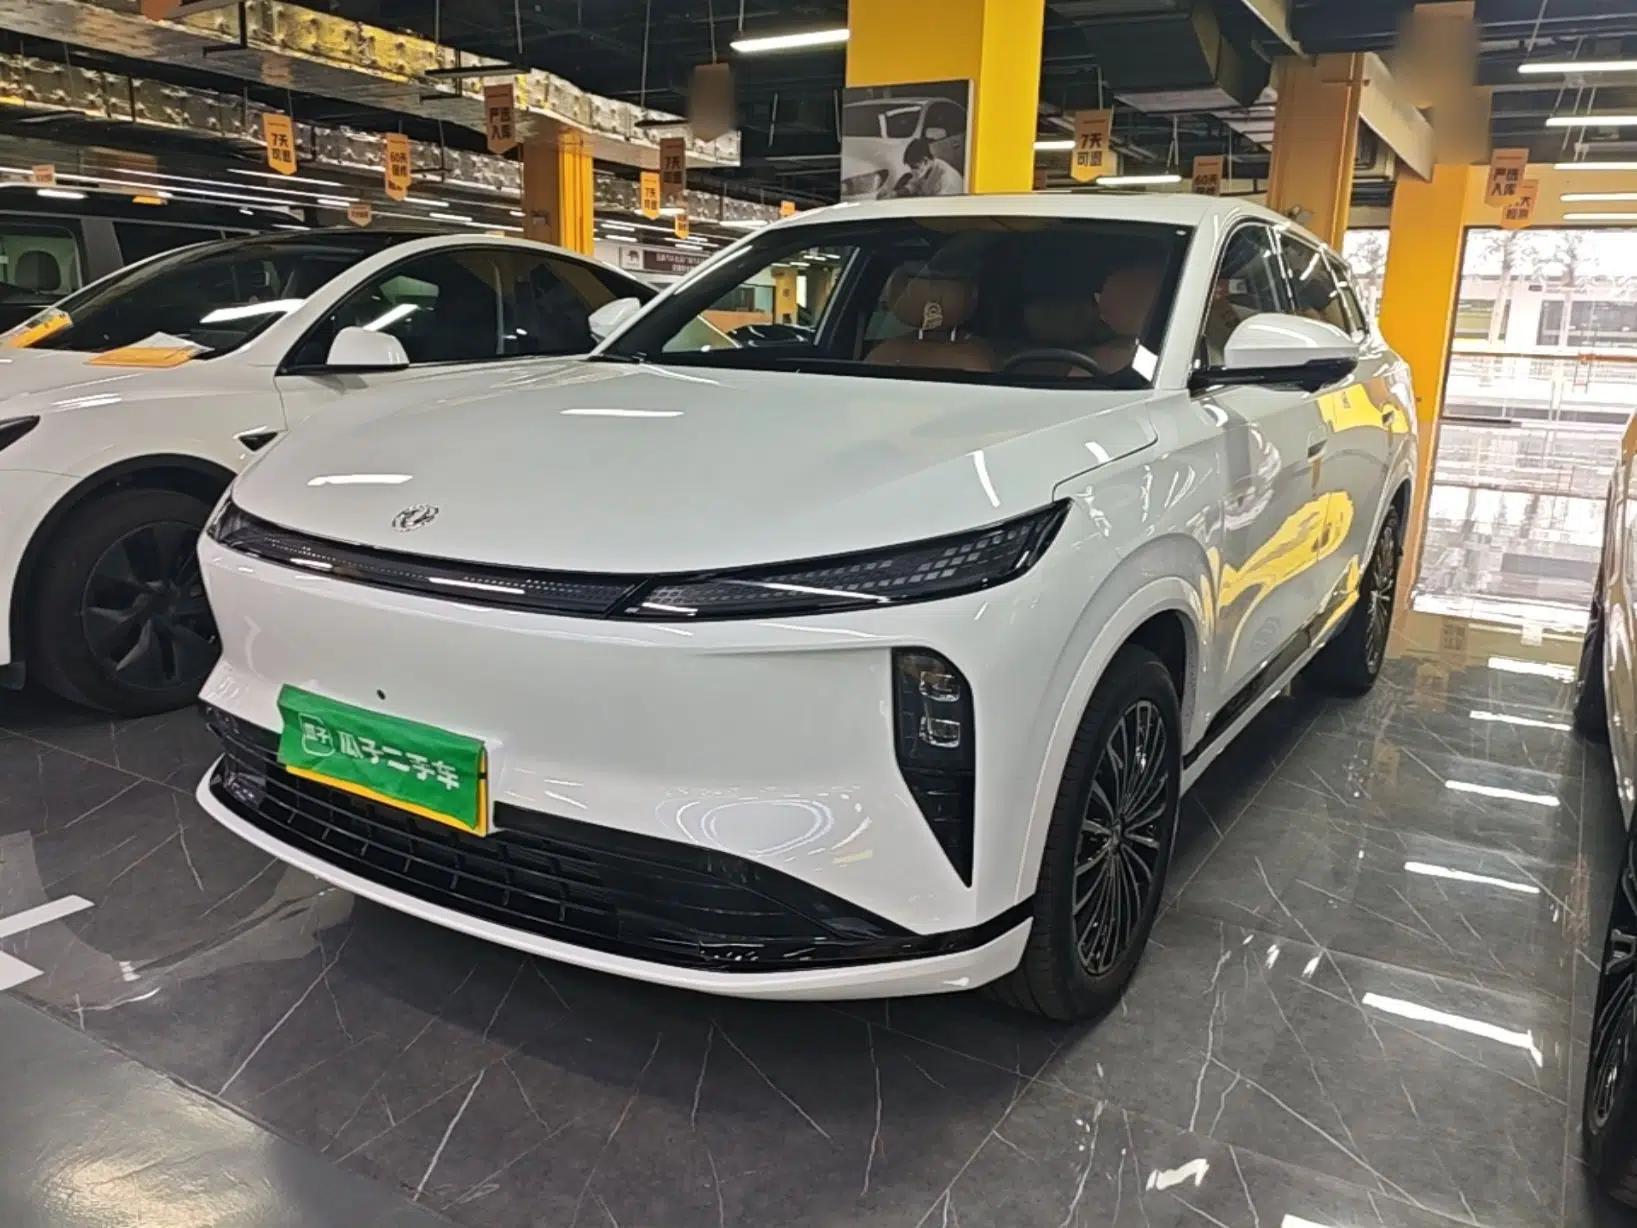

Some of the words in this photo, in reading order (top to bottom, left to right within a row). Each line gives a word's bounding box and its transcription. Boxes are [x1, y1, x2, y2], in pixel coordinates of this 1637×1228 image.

[271, 133, 289, 148] 7天
[1080, 133, 1103, 149] 7天
[1077, 151, 1103, 166] 可退
[337, 730, 460, 790] 瓜子二手车
